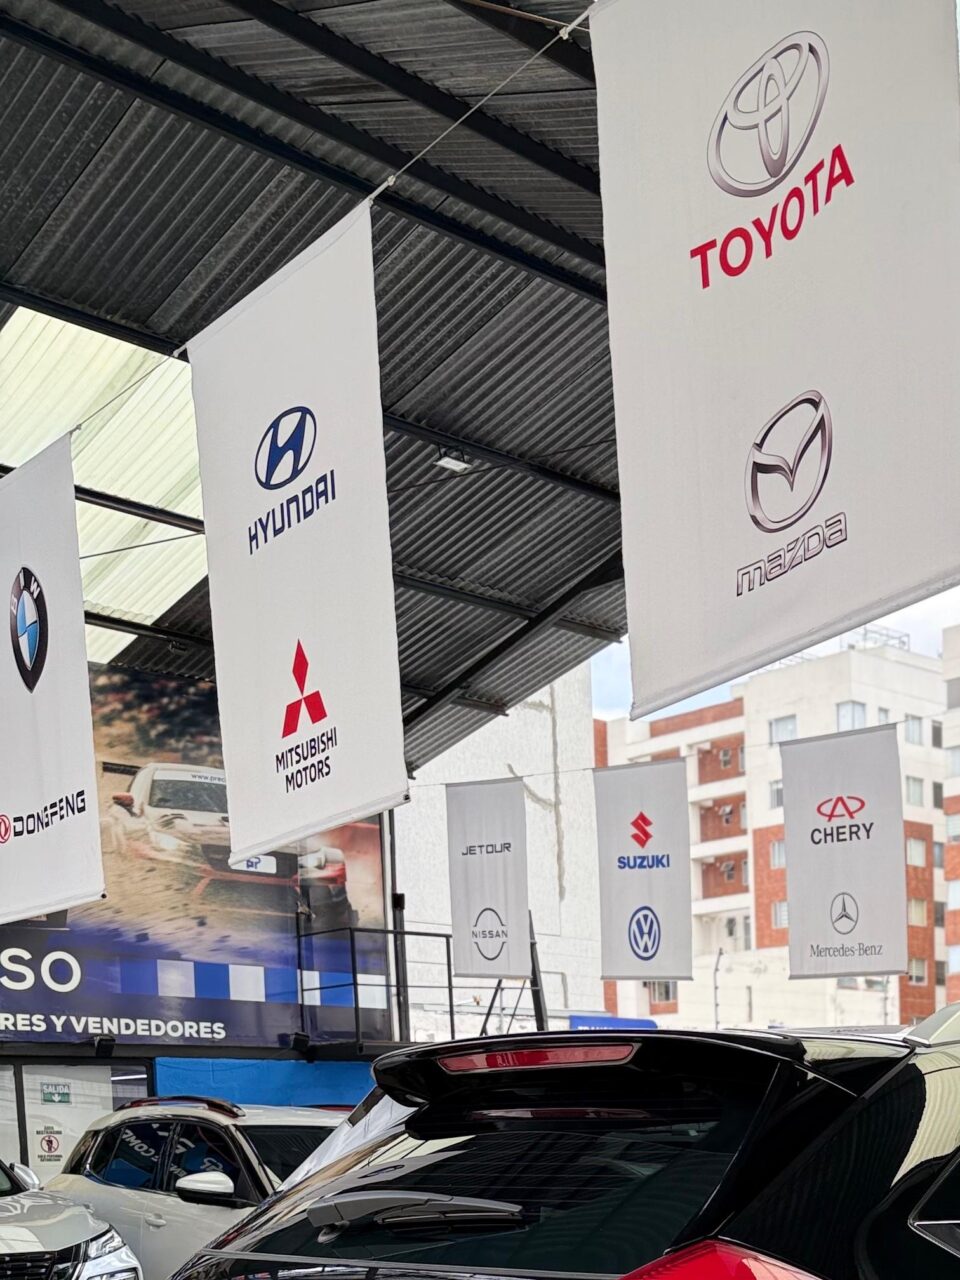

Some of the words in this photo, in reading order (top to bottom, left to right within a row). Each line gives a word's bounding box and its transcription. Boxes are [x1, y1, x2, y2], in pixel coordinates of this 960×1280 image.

[689, 143, 856, 290] TOYOTA
[248, 469, 336, 556] HYUNDAI
[275, 726, 337, 773] MITSUBISHI
[285, 755, 331, 793] MOTORS
[13, 789, 86, 837] DONGFENG
[810, 822, 874, 845] CHERY
[461, 842, 512, 856] JETOUR
[617, 854, 670, 870] SUZUKI
[471, 929, 509, 939] NISSAN
[809, 942, 883, 958] Mercedes-Benz
[50, 1014, 68, 1033] Y
[69, 1016, 226, 1039] VENDEDORES
[43, 1084, 70, 1094] SALIDA
